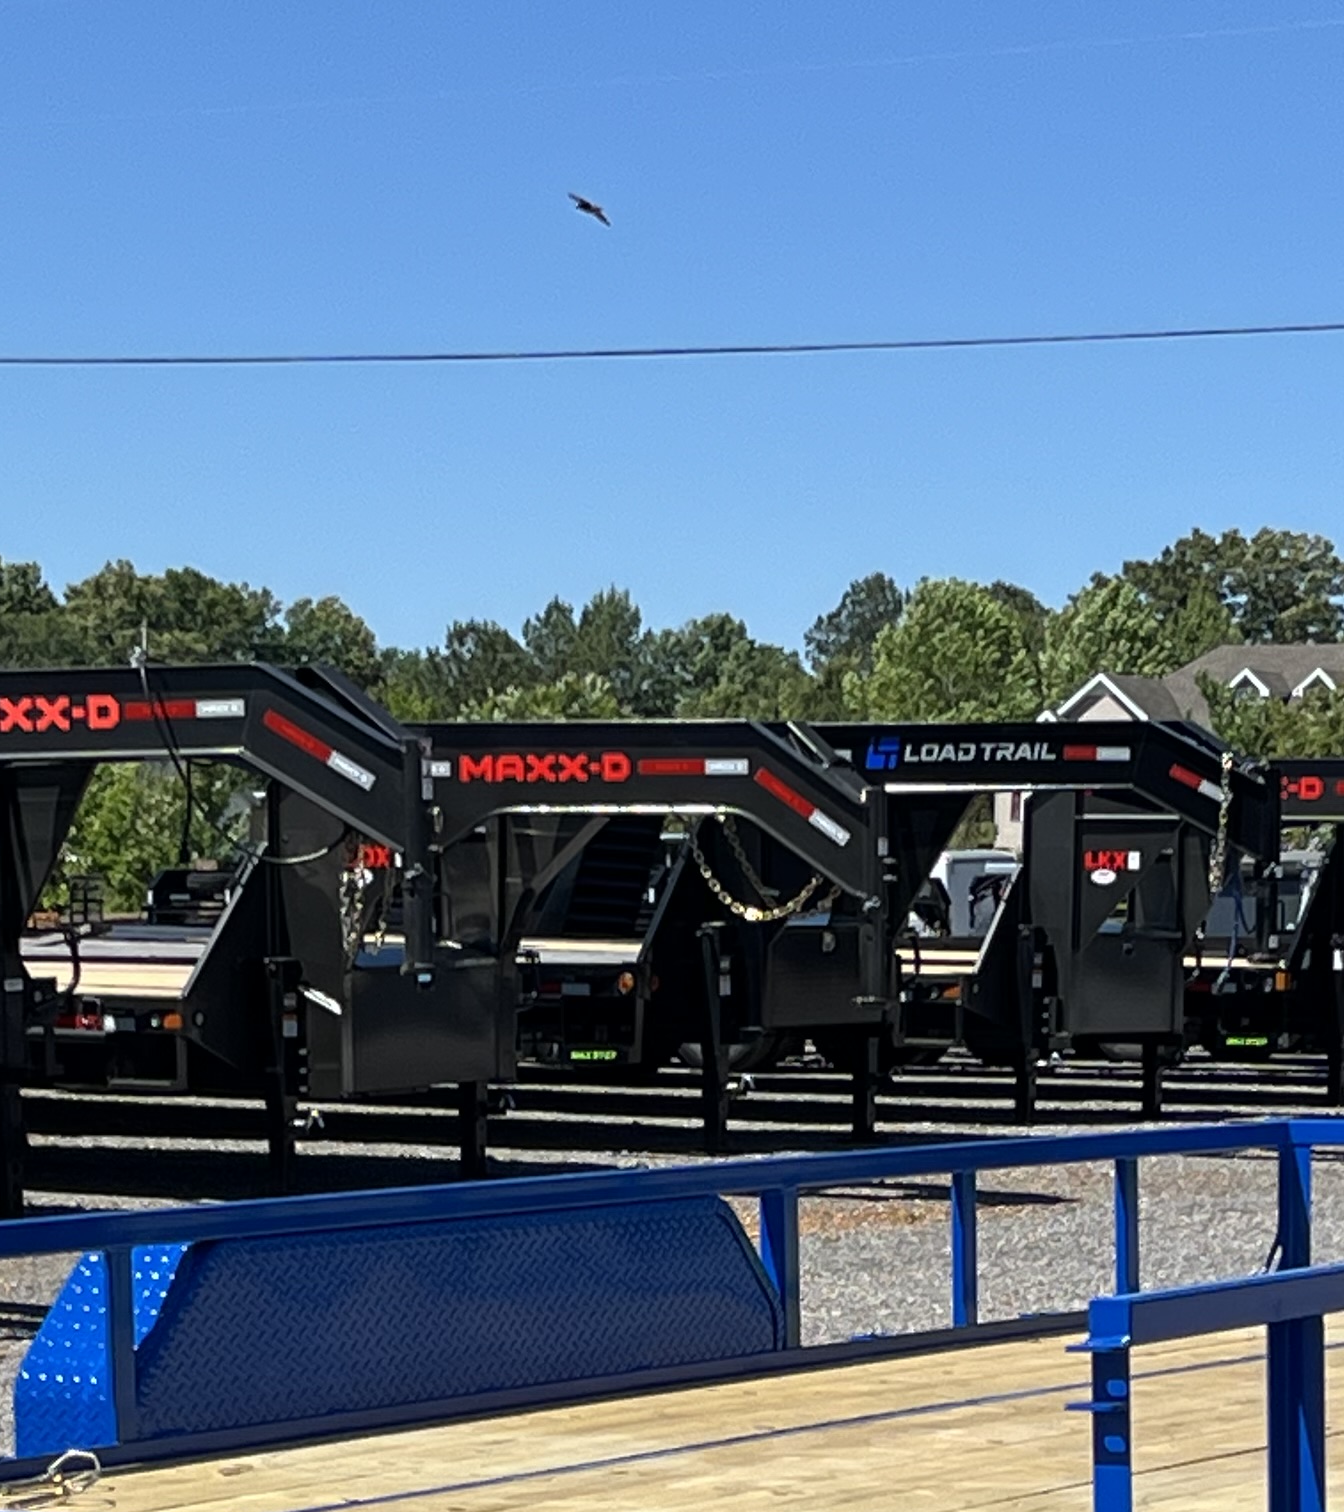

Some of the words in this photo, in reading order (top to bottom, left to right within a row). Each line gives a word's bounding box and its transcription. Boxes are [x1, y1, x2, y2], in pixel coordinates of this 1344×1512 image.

[904, 743, 976, 762] LOAD
[980, 742, 1056, 761] TRAIL
[459, 752, 631, 783] MAXX-D
